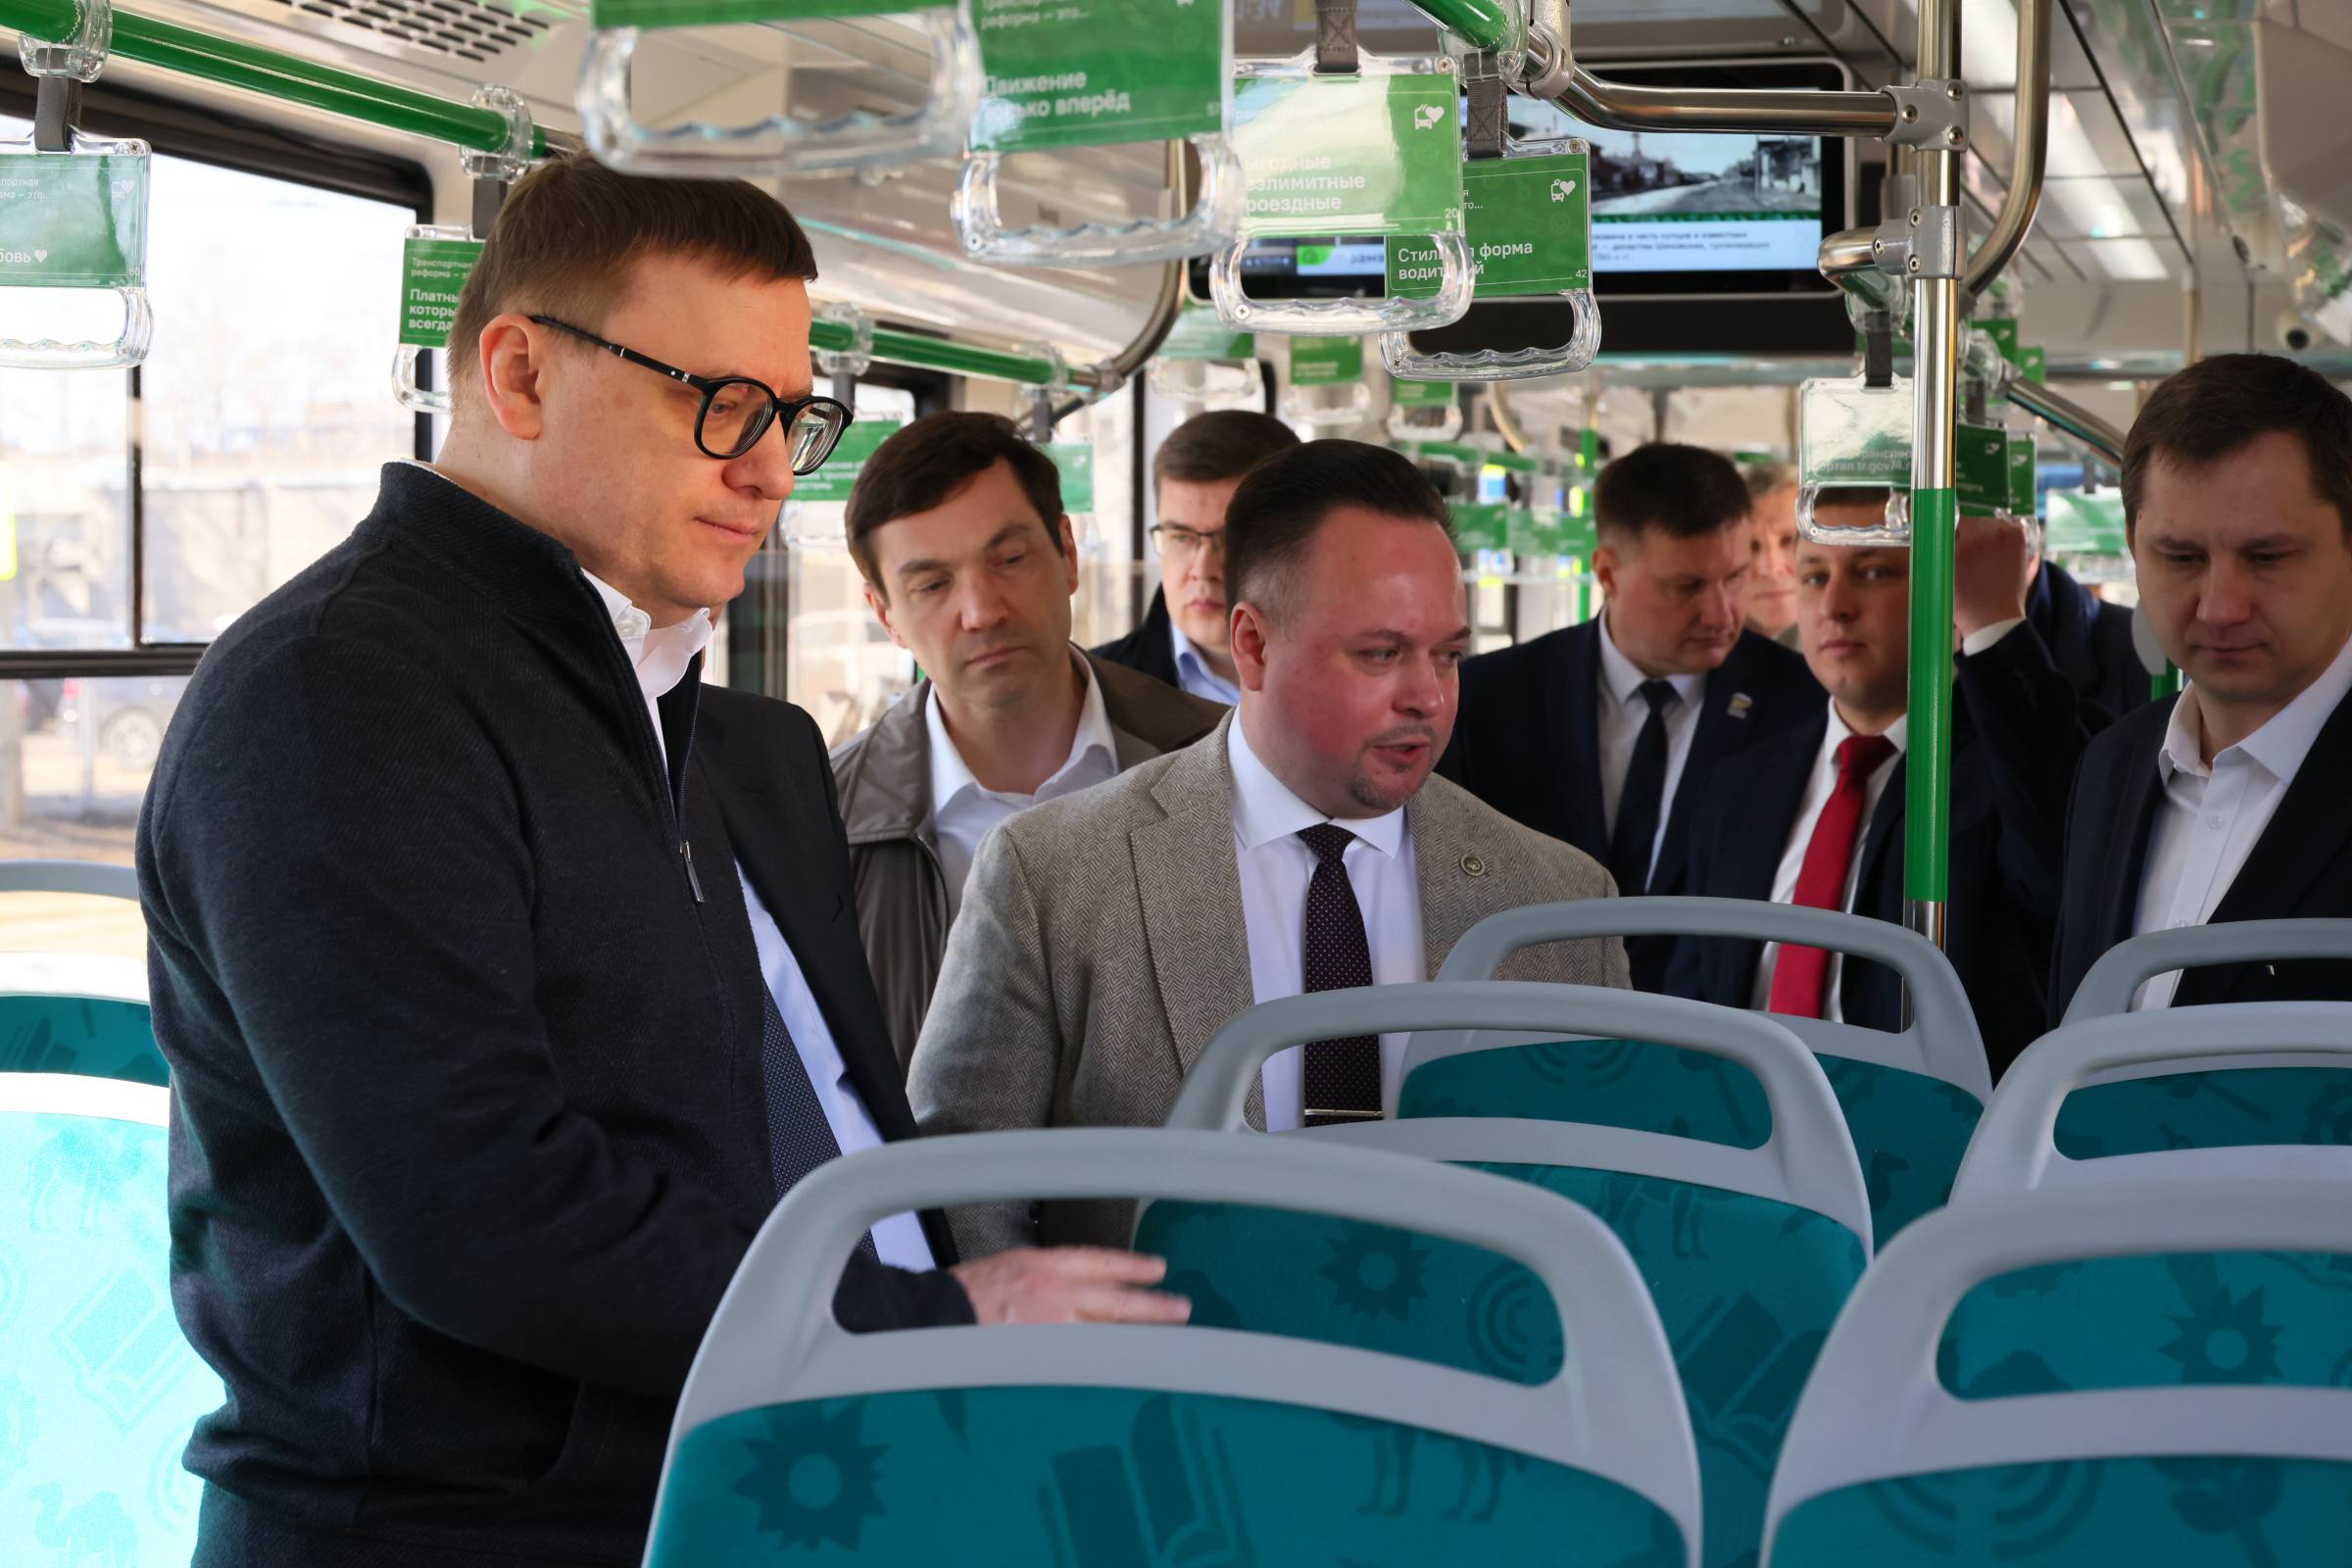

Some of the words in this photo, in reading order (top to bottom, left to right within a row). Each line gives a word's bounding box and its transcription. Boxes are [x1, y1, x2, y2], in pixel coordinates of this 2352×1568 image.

[983, 72, 1088, 99] Движение
[1054, 88, 1131, 118] вперёд
[1246, 155, 1333, 172] ыгодные
[1246, 174, 1365, 192] езлимитные
[1246, 196, 1343, 217] роездные
[1445, 208, 1458, 220] 20
[1480, 242, 1533, 260] форма
[1576, 270, 1587, 278] 42
[1857, 461, 1911, 472] tr.gov74.r
